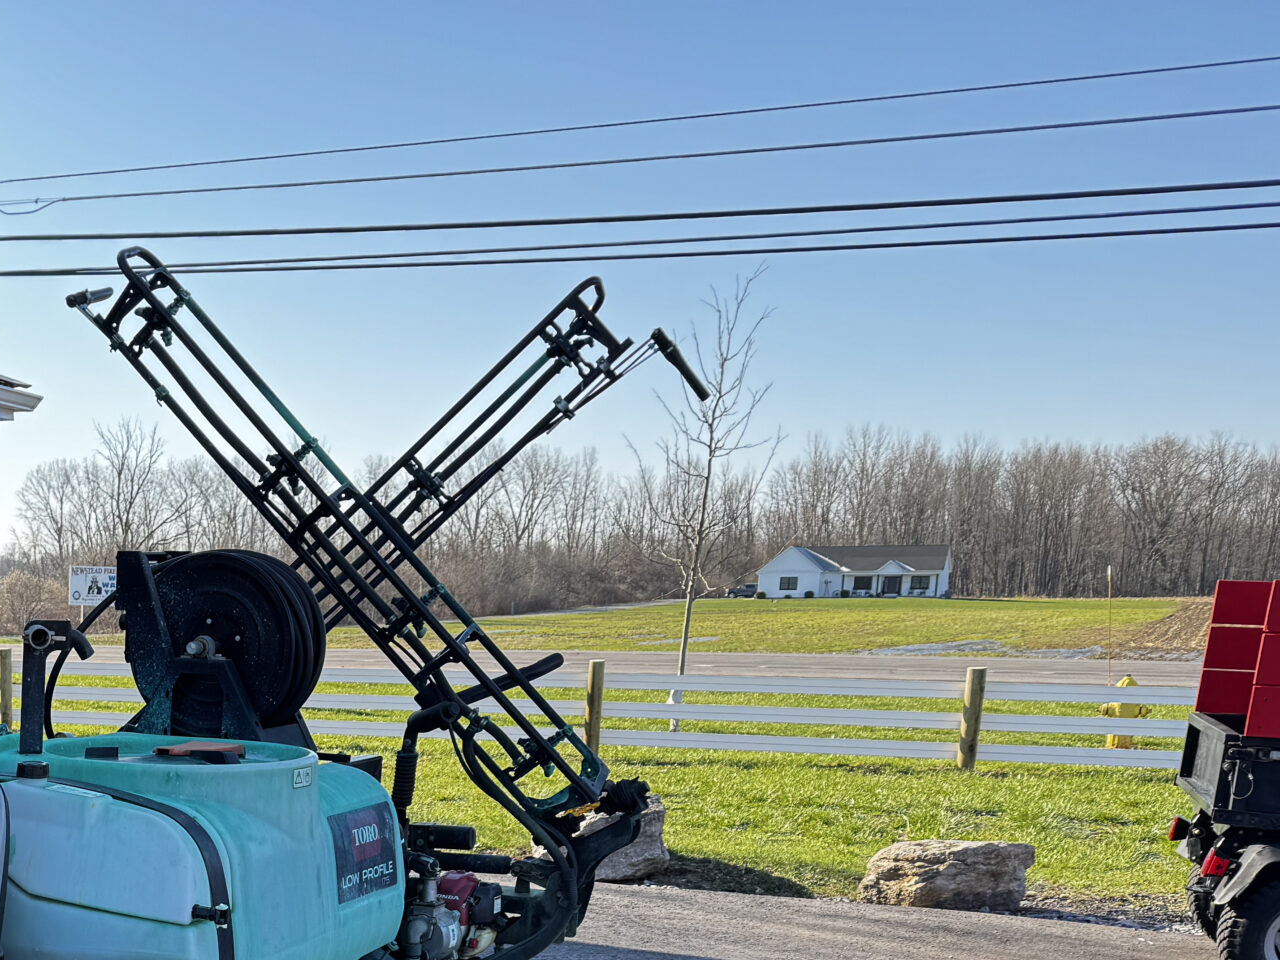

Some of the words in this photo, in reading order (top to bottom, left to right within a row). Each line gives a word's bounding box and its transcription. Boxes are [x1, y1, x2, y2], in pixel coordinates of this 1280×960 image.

[71, 567, 103, 576] NEWSTEAD
[352, 823, 379, 846] TORO
[342, 871, 360, 889] LOW
[362, 860, 394, 882] PROFILE
[436, 893, 460, 901] ONDA
